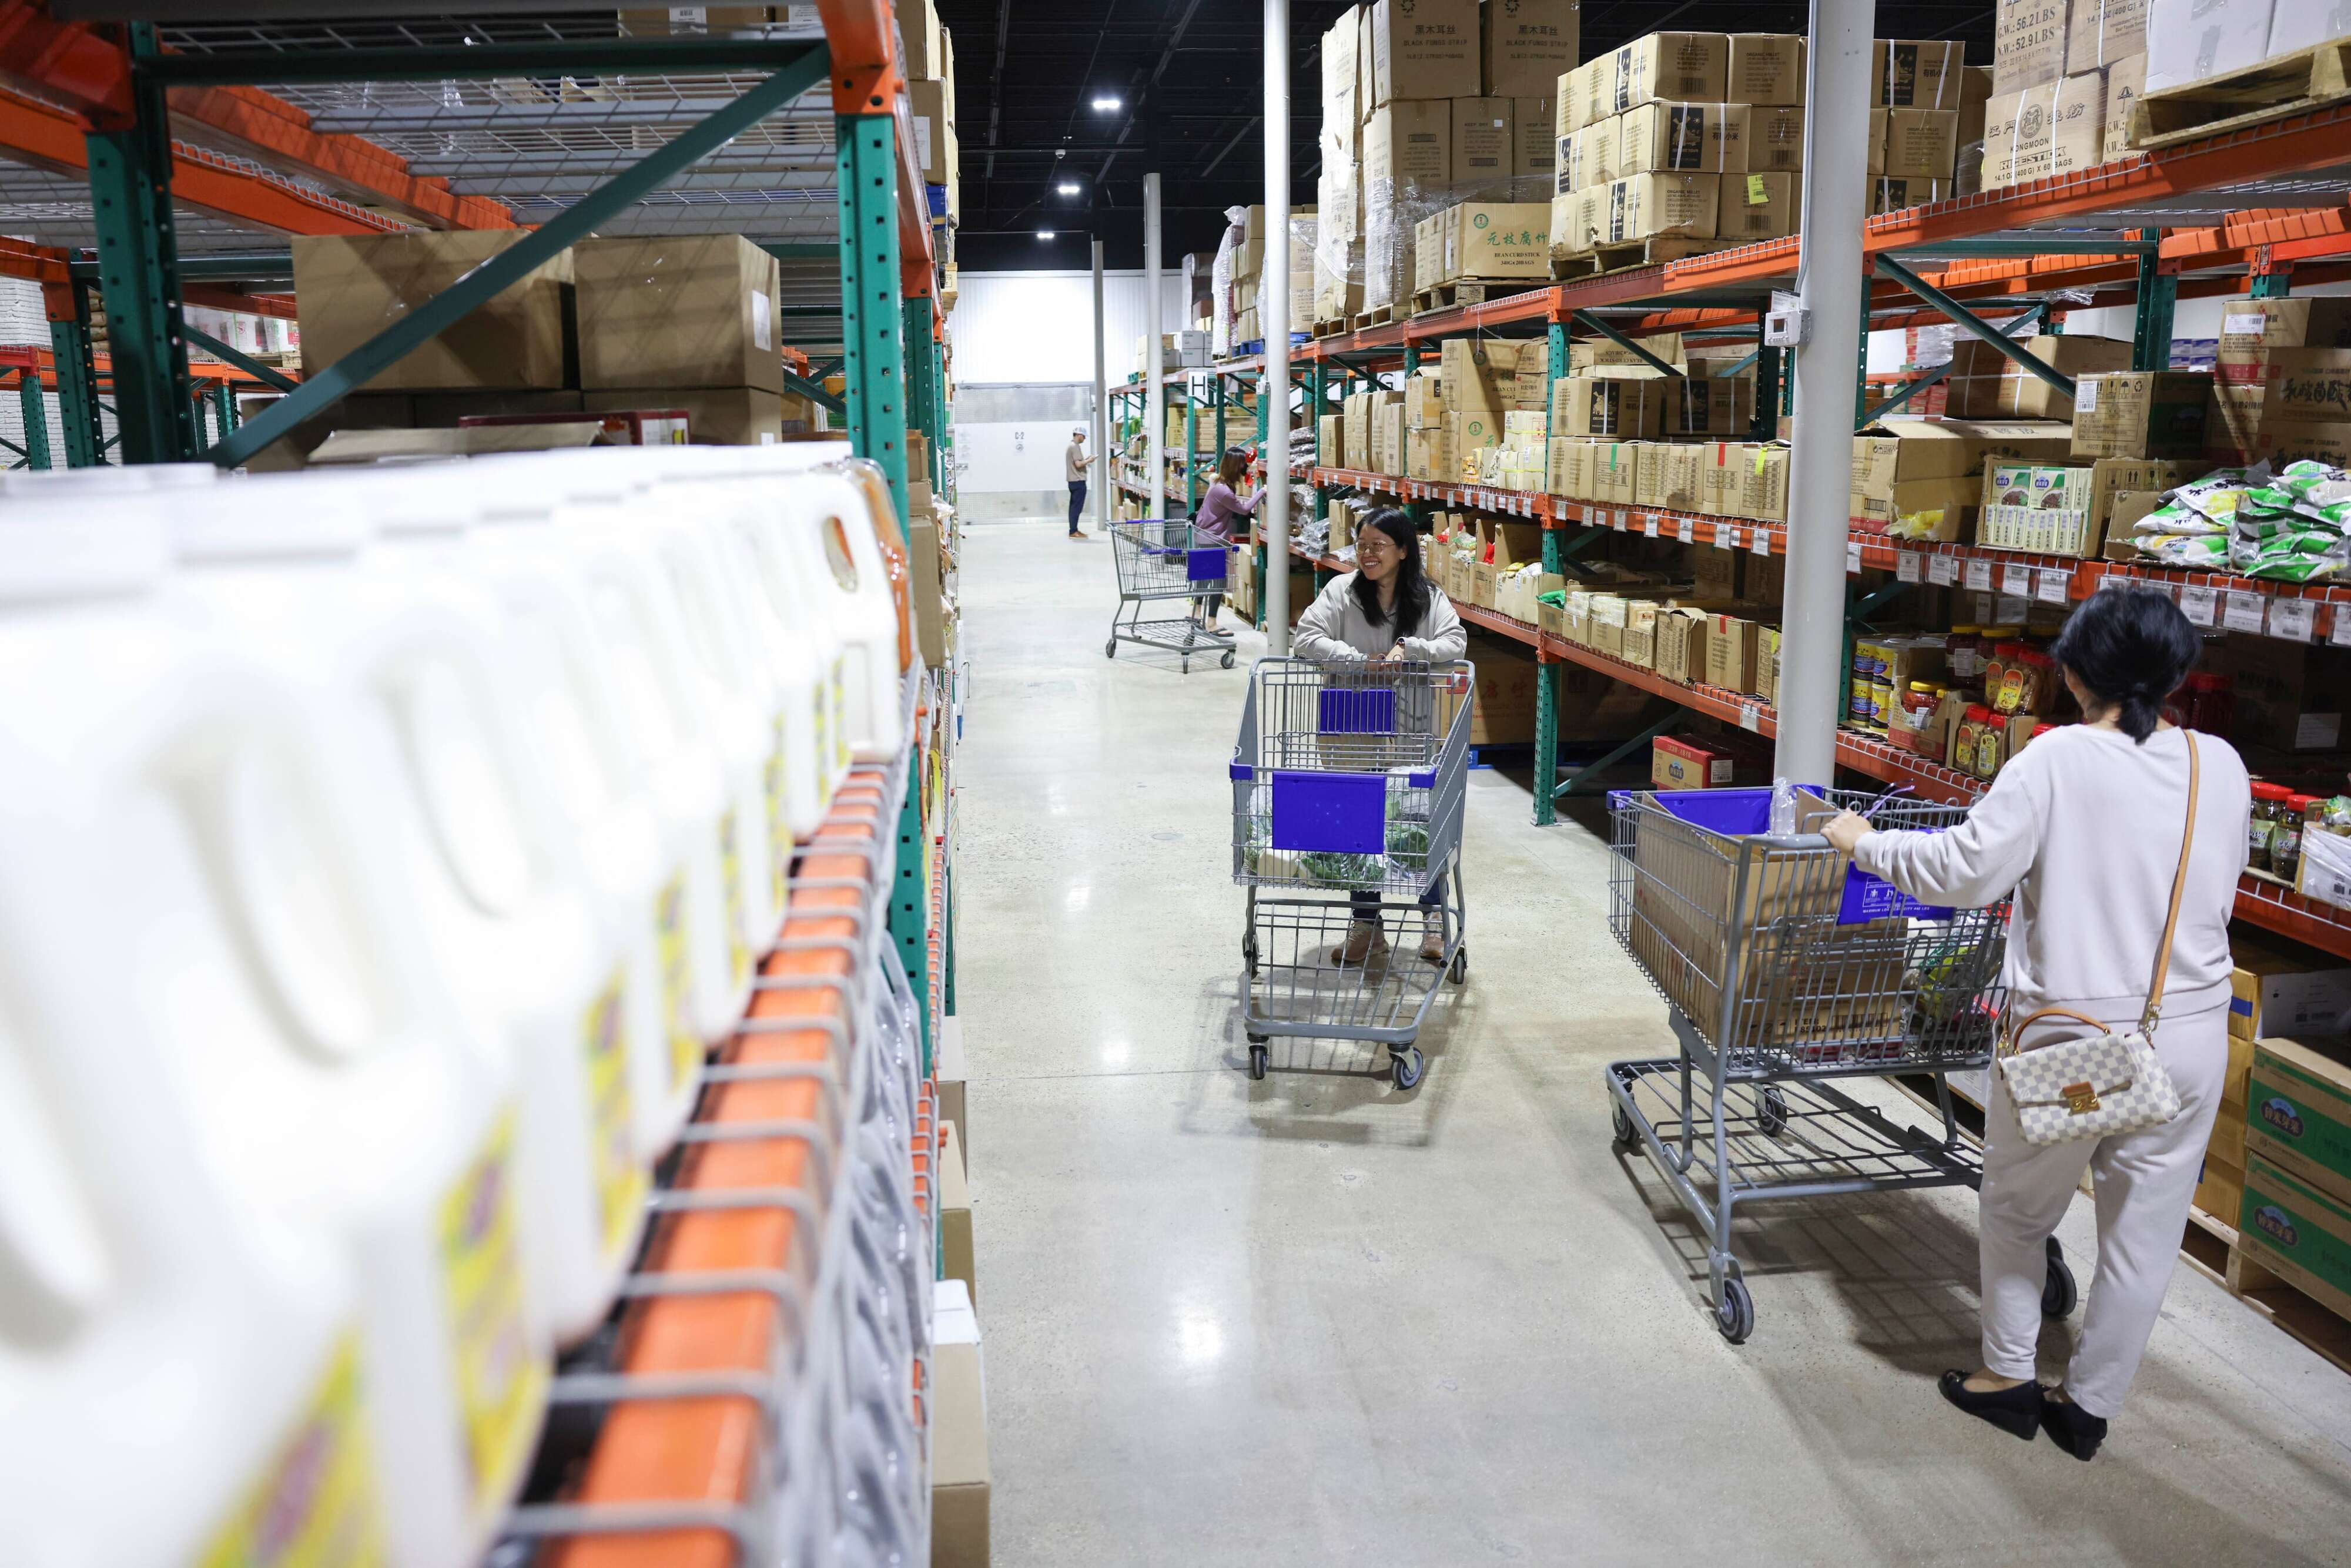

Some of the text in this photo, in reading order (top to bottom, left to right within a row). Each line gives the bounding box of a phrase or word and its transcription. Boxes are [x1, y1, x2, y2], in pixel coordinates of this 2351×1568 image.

[2035, 6, 2055, 25] LBS
[1415, 25, 1456, 35] 黑木耳丝
[1518, 25, 1558, 35] 黑木耳丝
[2035, 26, 2055, 44] LBS
[1487, 230, 1548, 246] 元枝腐竹
[1192, 376, 1205, 395] H
[1379, 373, 1394, 390] G
